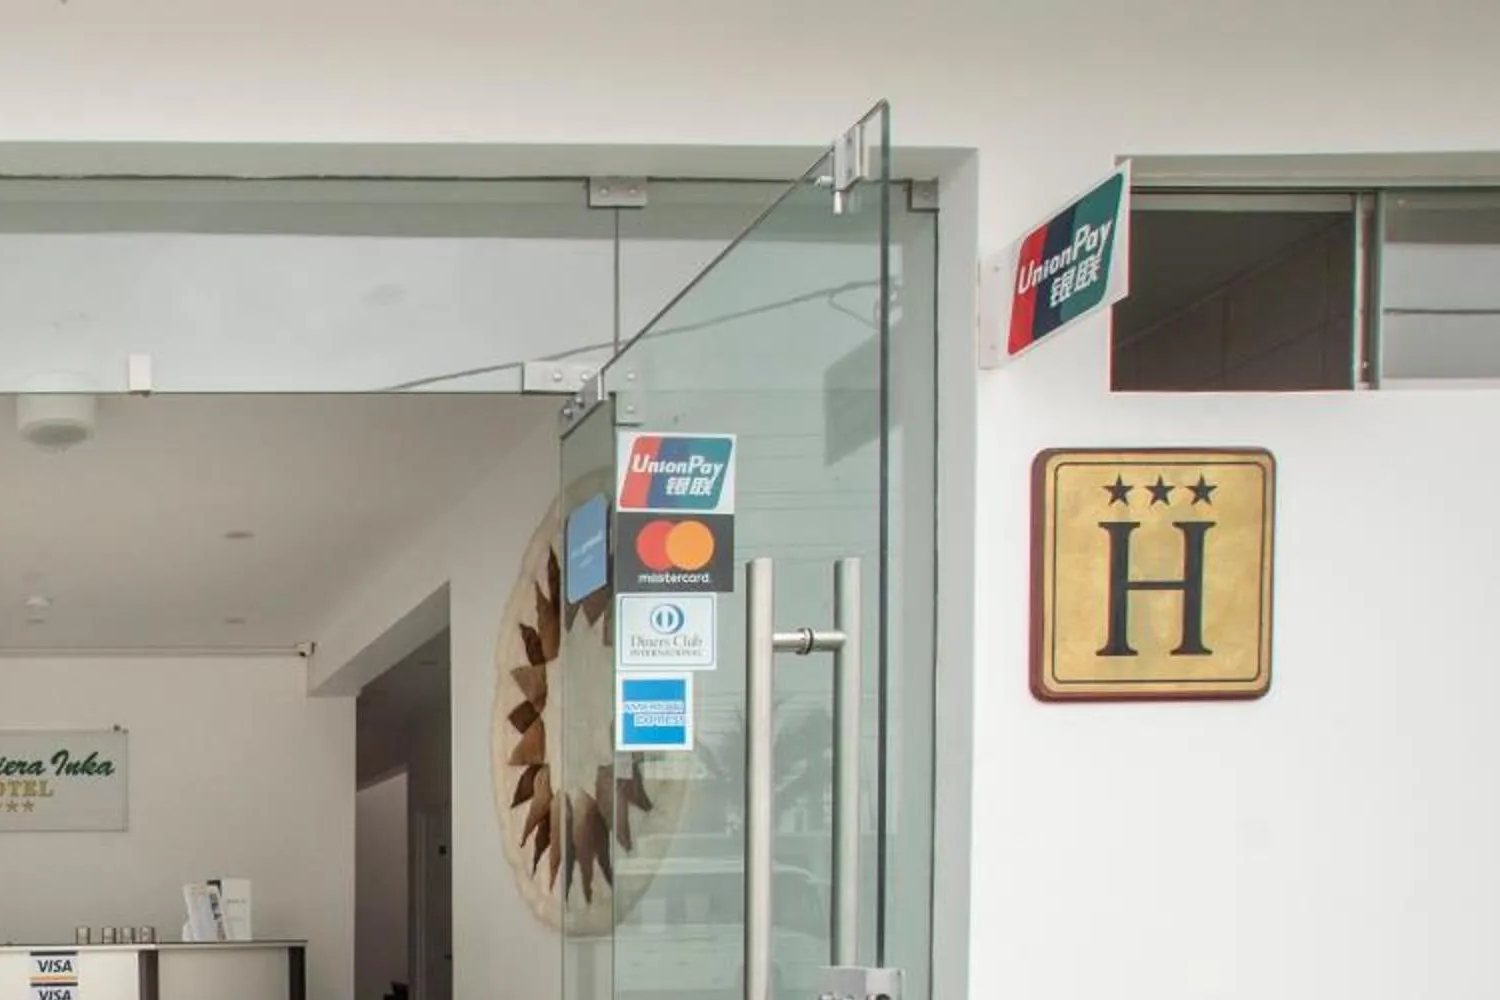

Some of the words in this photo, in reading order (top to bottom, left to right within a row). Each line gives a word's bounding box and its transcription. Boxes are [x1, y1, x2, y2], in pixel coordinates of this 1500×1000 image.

[1018, 219, 1113, 296] UnionPay
[632, 453, 724, 479] UnionPay
[638, 572, 710, 583] mastercard
[1096, 521, 1217, 657] H
[673, 634, 703, 648] Club
[51, 750, 115, 777] Inka
[36, 959, 73, 973] VISA
